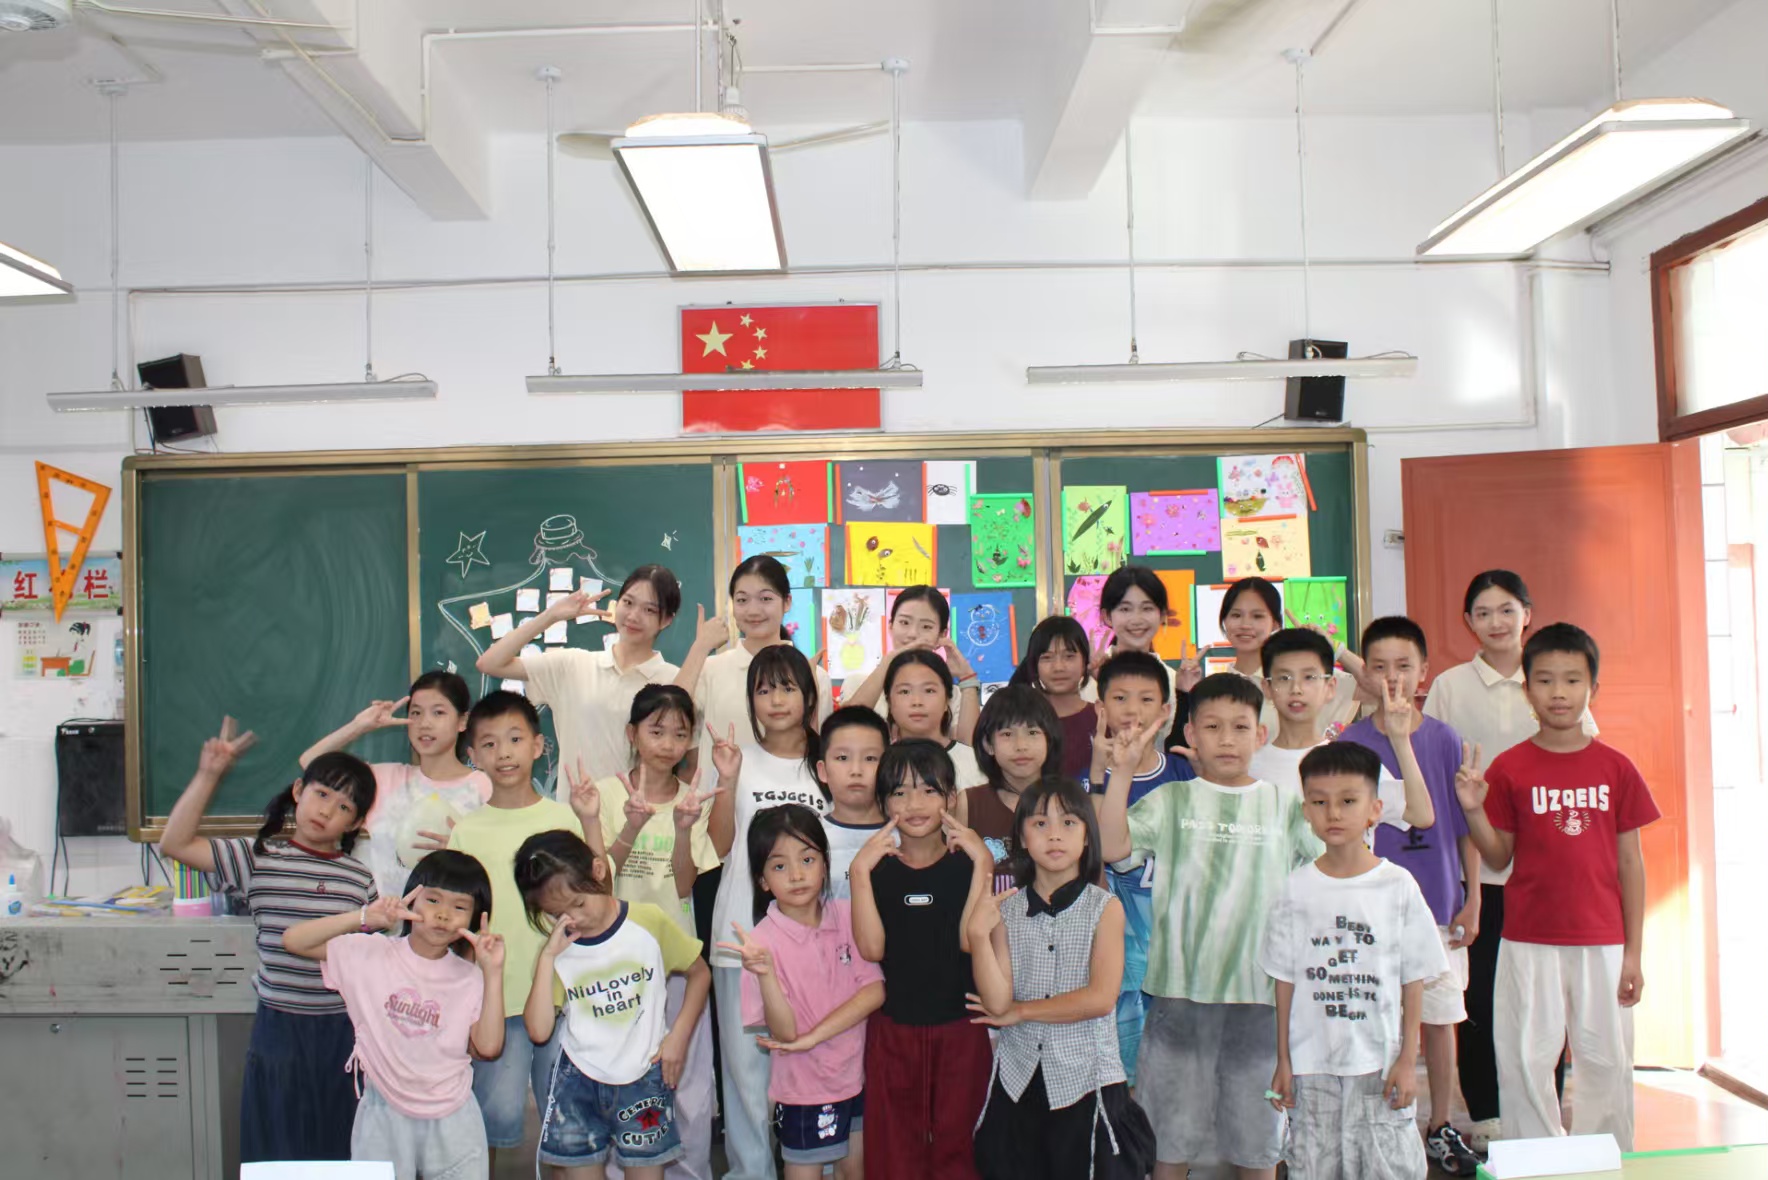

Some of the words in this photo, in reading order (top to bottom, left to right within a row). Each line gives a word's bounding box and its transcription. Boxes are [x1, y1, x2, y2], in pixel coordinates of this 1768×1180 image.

[13, 569, 109, 600] 红栏
[1354, 932, 1376, 946] TO
[1328, 949, 1358, 967] GET
[567, 966, 654, 1002] NiuLovely
[592, 993, 642, 1019] heart
[607, 990, 623, 1003] in
[1313, 991, 1344, 1002] DONE
[384, 993, 440, 1028] Sunlight
